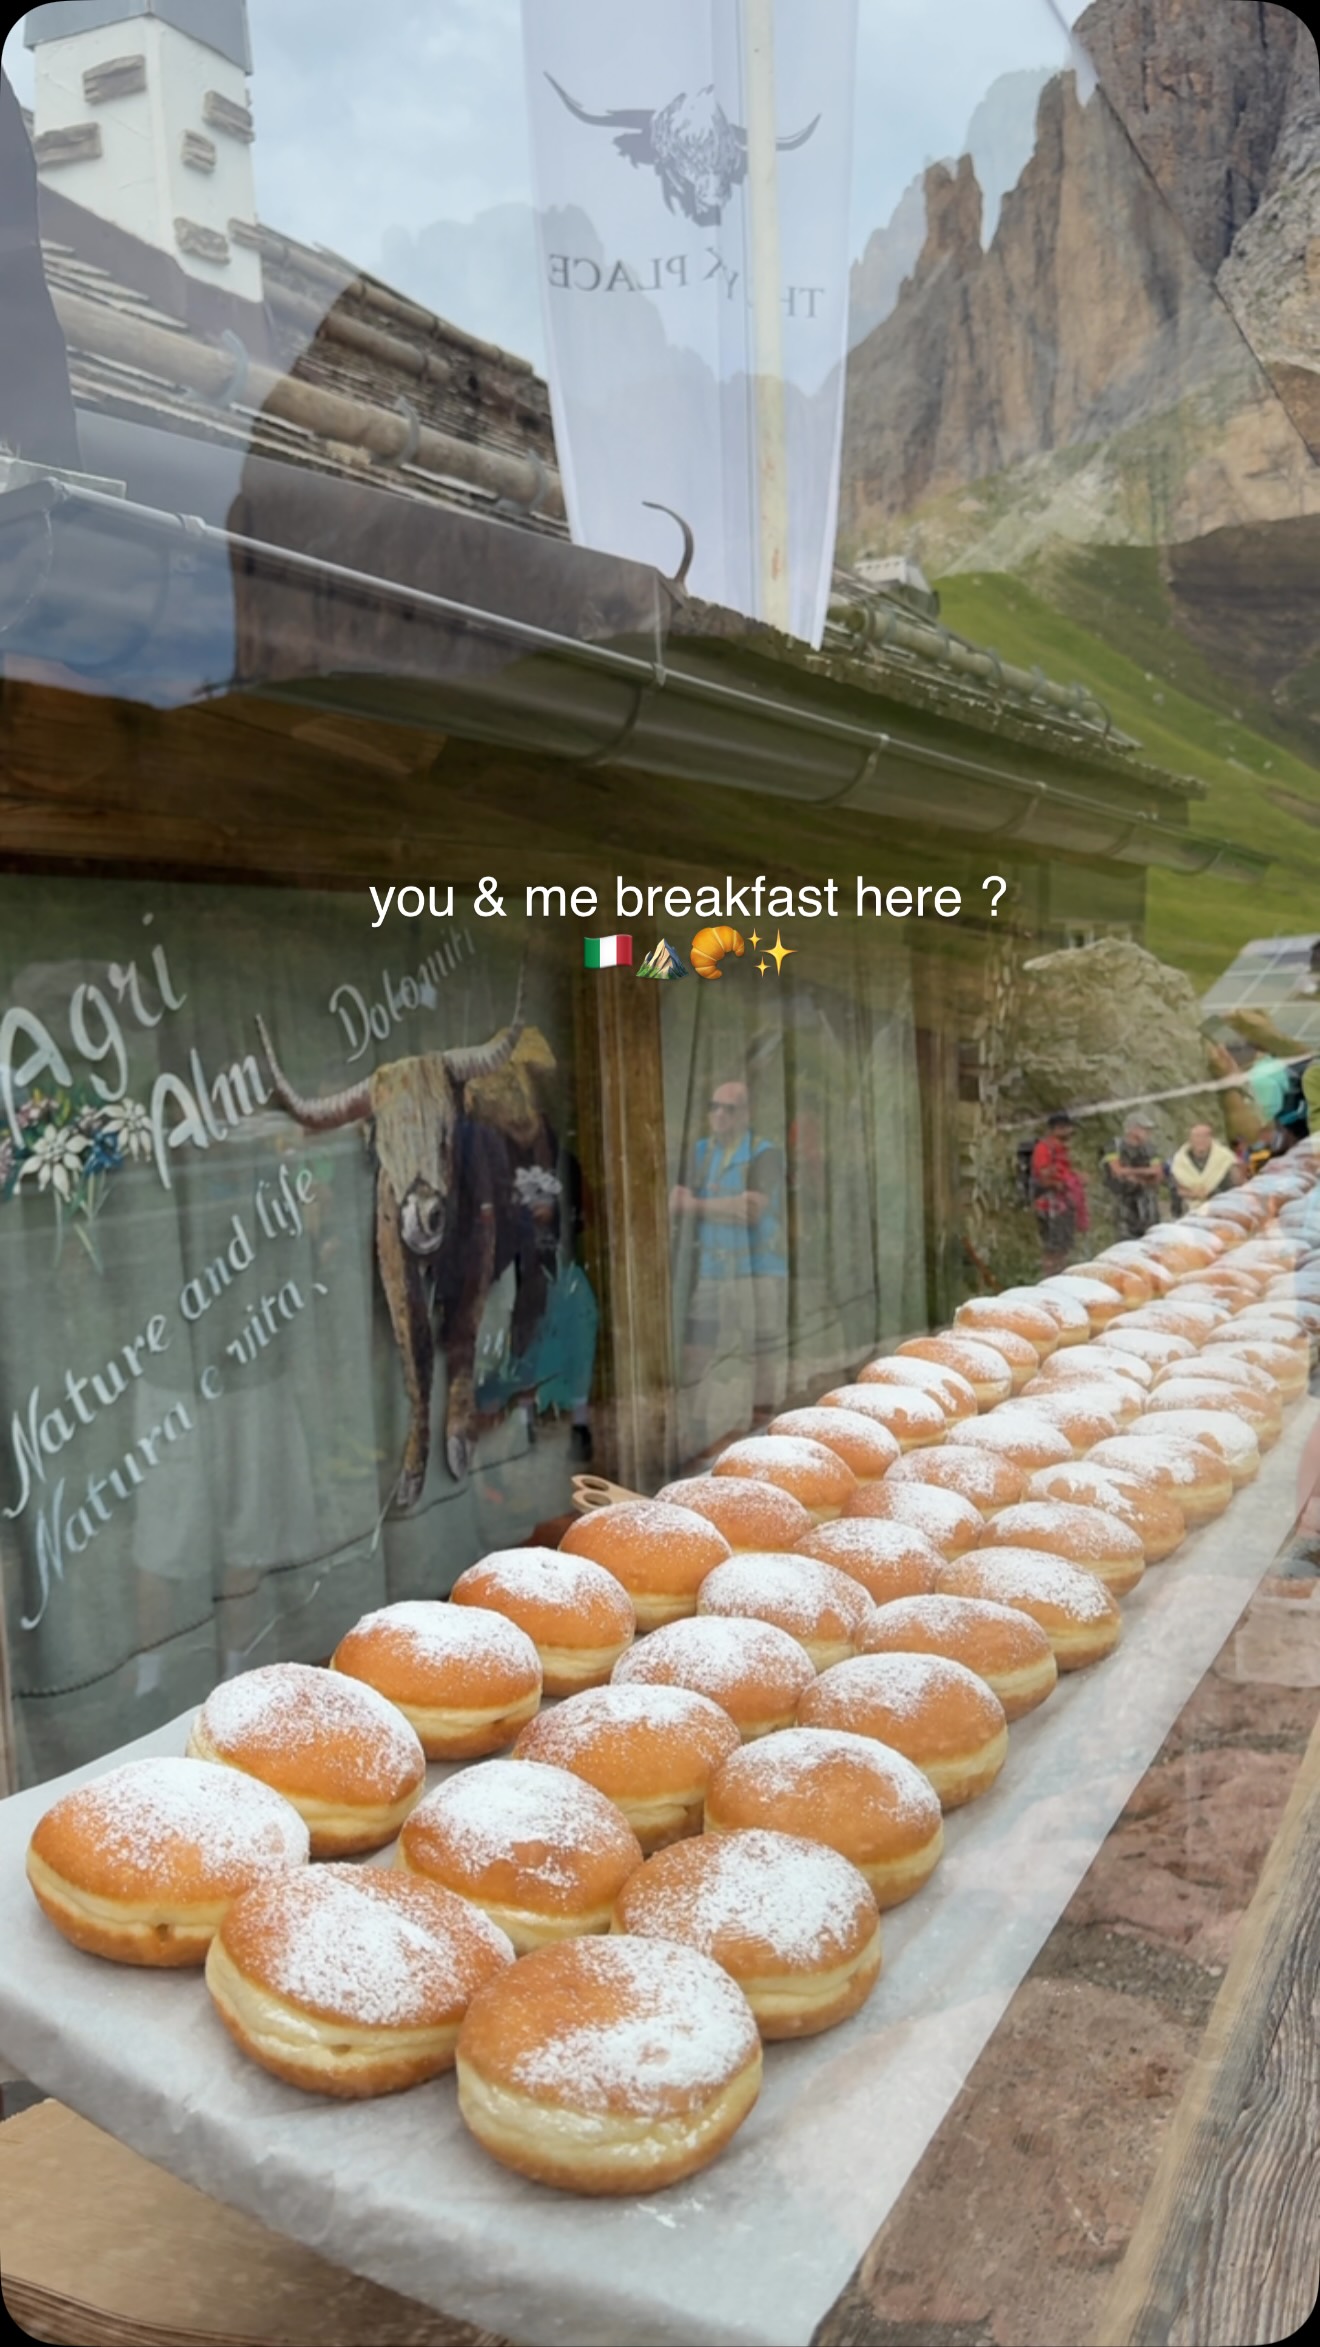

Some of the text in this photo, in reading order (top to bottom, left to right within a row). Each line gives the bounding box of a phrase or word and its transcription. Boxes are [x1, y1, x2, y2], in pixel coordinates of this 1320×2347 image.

[0, 912, 187, 1148] Agri
[152, 1048, 273, 1189] Alm
[4, 1164, 316, 1520] Nature and life
[21, 1401, 194, 1631] Natura
